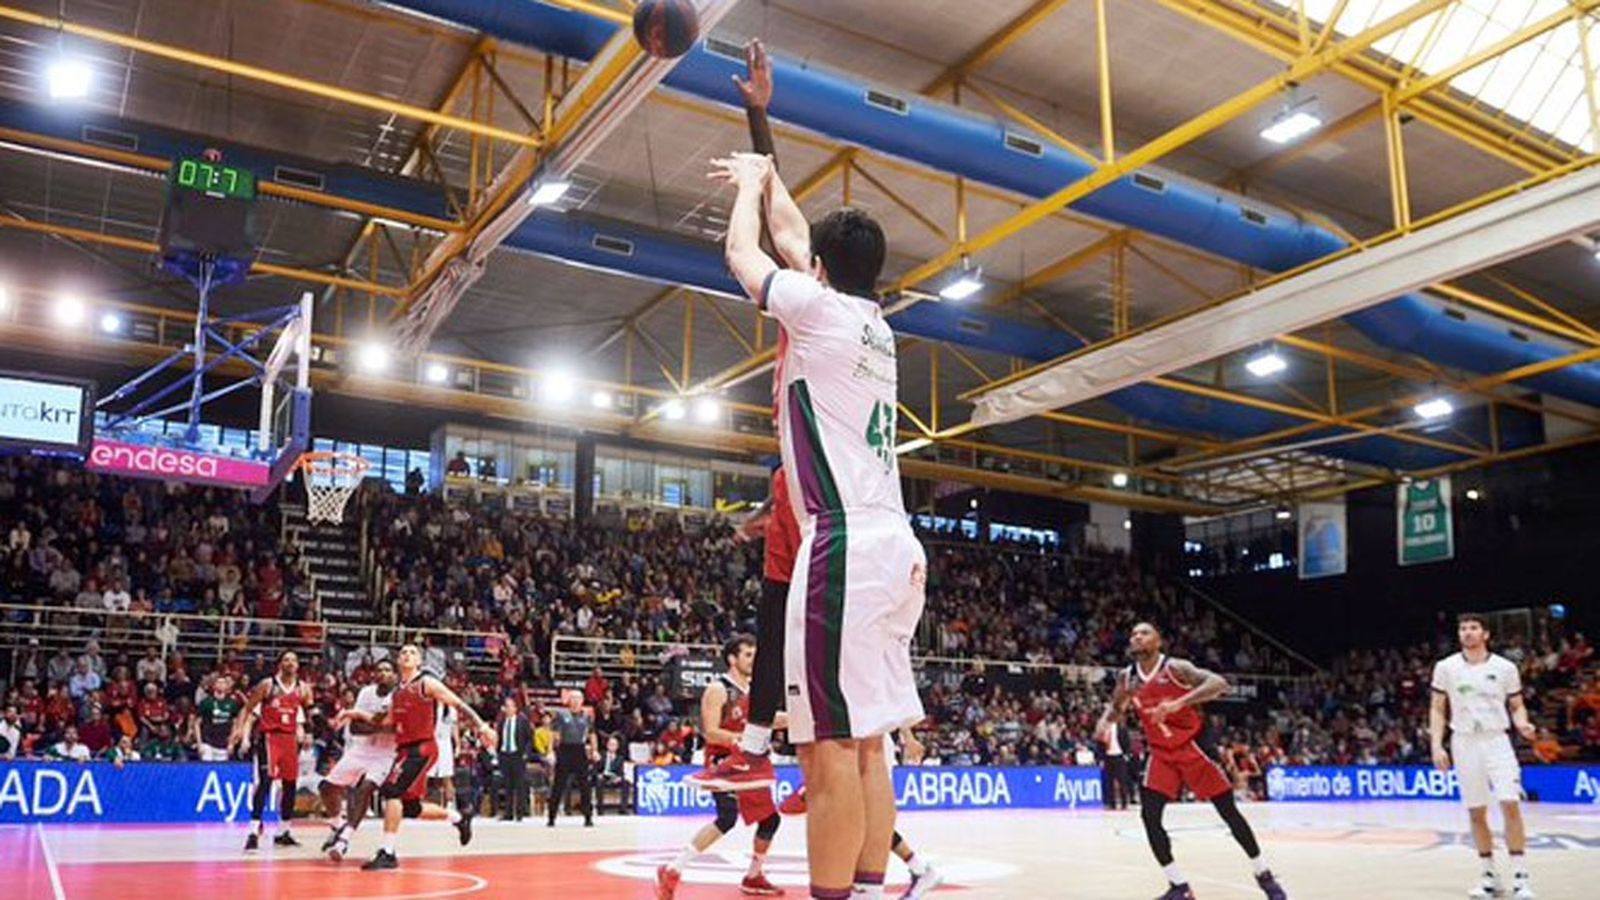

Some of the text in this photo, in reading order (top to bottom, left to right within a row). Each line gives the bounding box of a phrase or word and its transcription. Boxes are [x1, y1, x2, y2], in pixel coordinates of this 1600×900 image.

[91, 445, 218, 477] endesa
[1413, 513, 1436, 533] 10
[1054, 773, 1100, 808] Ayun
[1332, 771, 1352, 796] de
